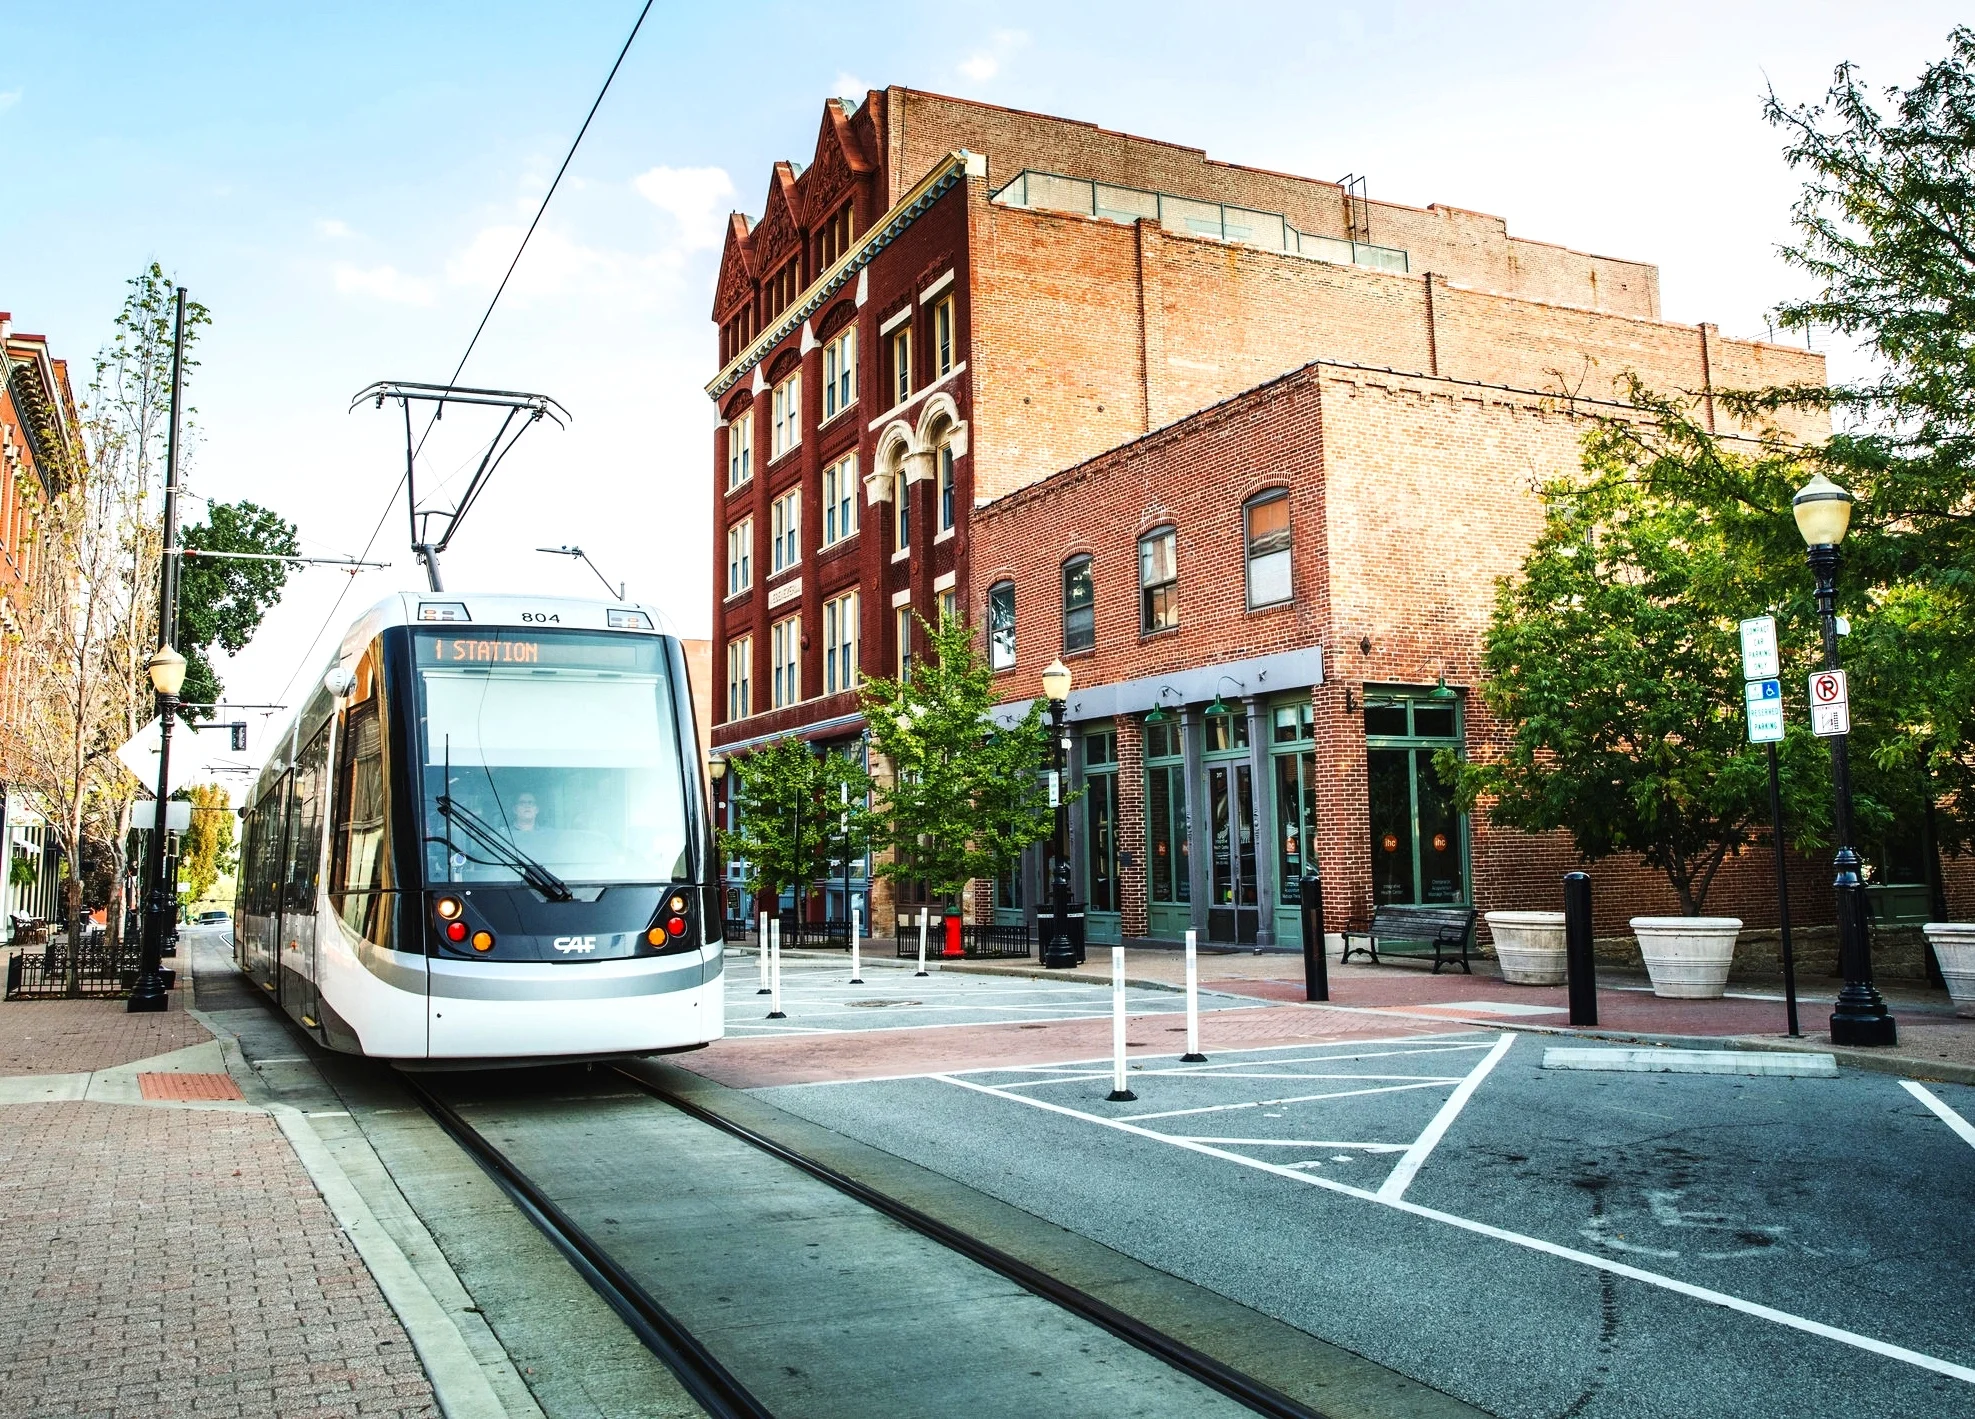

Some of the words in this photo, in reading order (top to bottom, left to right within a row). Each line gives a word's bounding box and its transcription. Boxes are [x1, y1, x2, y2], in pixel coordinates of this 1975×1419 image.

[521, 612, 561, 624] 804
[1753, 638, 1764, 647] CAR
[453, 640, 538, 663] STATION
[1748, 649, 1771, 659] PARKING
[1753, 662, 1768, 671] ONLY
[1754, 721, 1778, 732] PARKING
[1385, 838, 1396, 847] ihc
[1435, 837, 1446, 847] ihc
[553, 936, 597, 954] CAF
